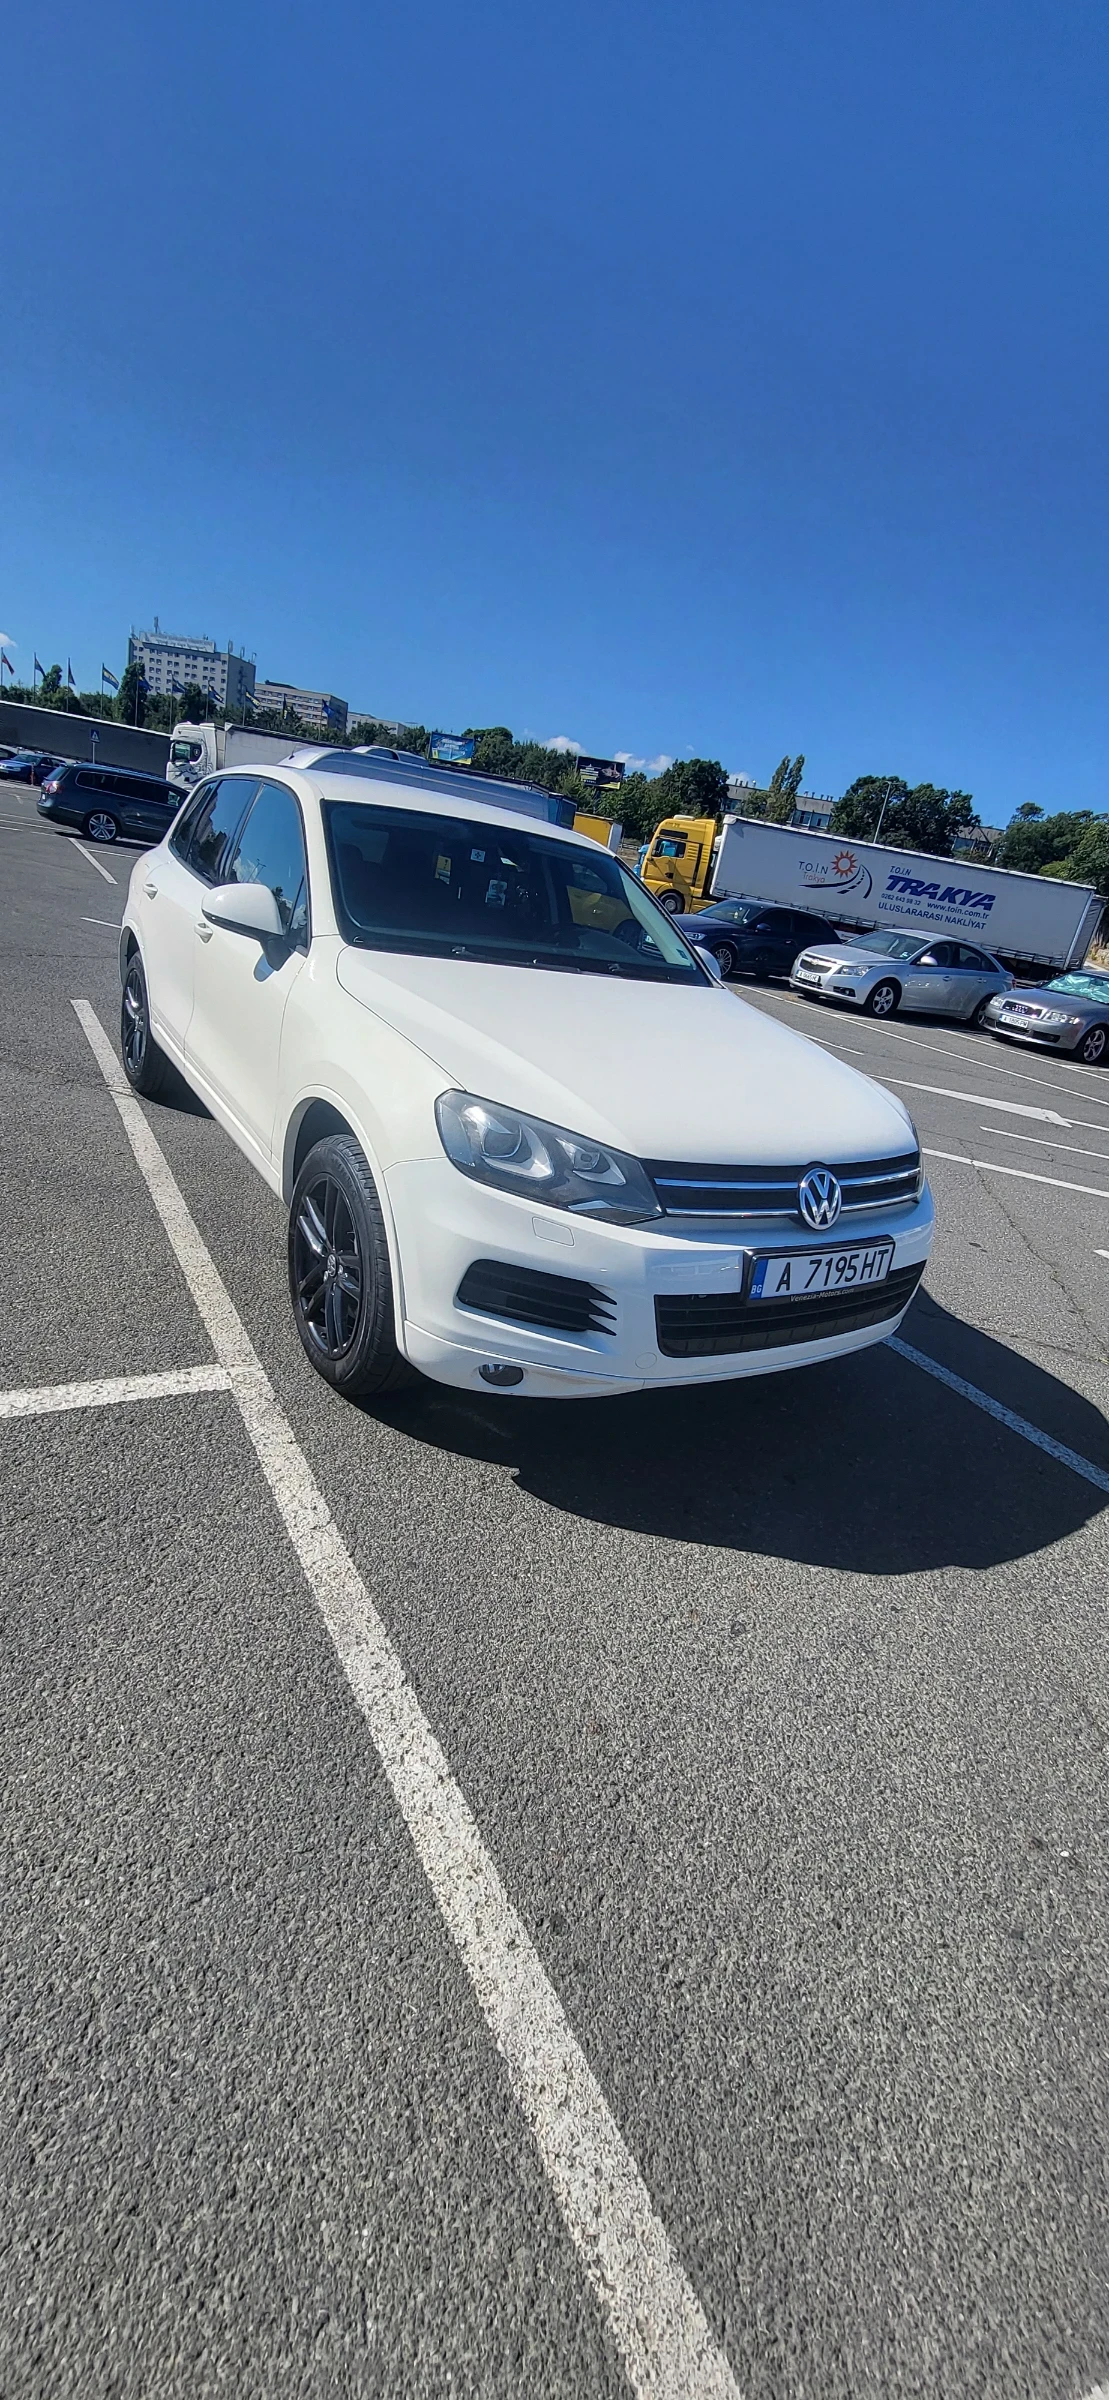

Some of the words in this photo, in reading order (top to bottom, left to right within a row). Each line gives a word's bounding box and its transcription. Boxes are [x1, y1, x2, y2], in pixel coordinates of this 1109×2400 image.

[885, 874, 997, 911] TRAKYA
[877, 901, 944, 922] ULUSLARARASI
[927, 902, 989, 920] www.toin.com.tr
[775, 1261, 791, 1293] A
[750, 1283, 762, 1294] BG
[790, 1287, 855, 1302] Venezia-Motors.com
